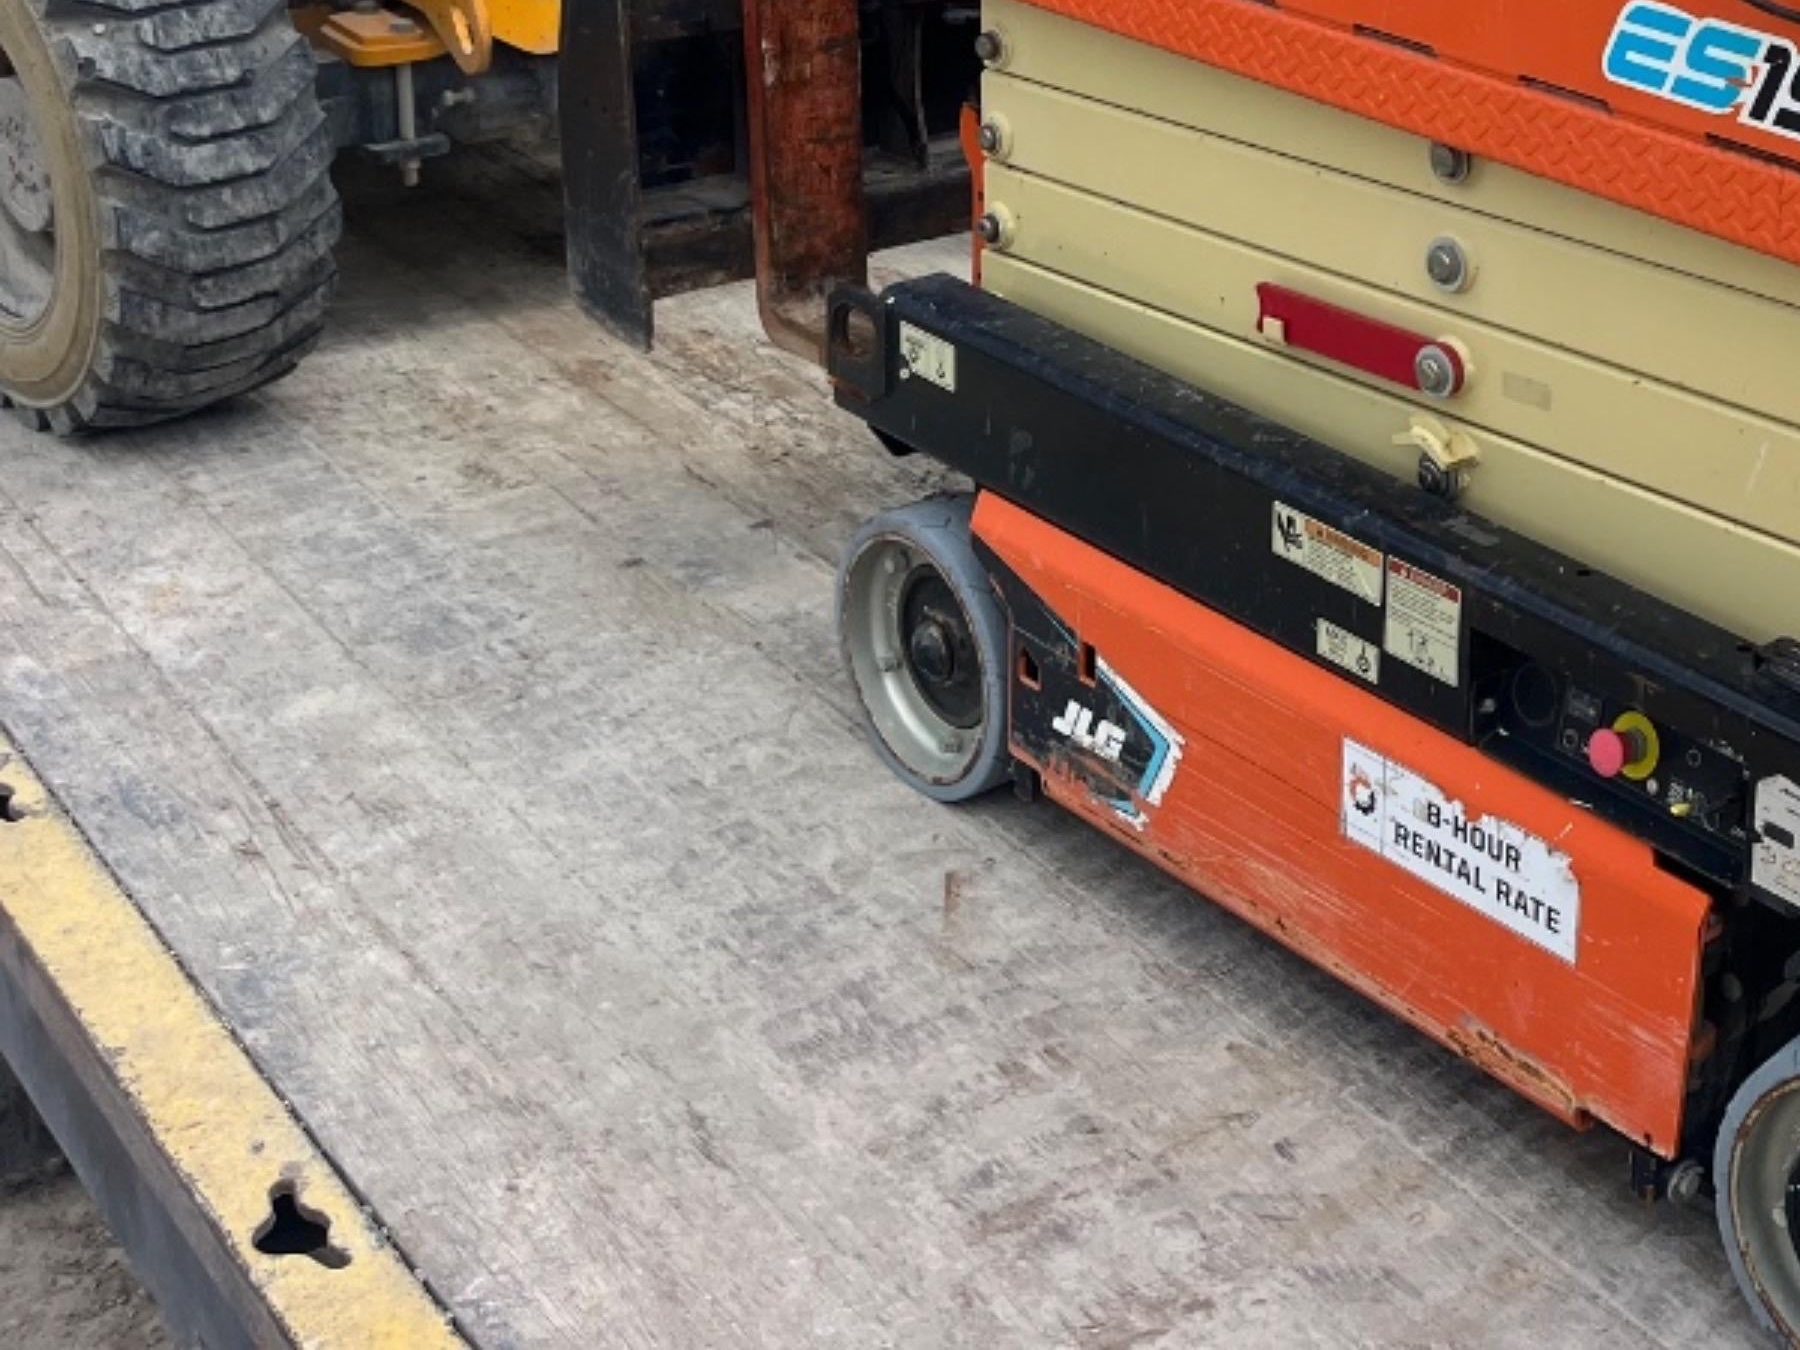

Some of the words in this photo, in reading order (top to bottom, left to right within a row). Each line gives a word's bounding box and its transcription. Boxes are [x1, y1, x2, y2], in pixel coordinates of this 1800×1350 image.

[1052, 698, 1127, 762] JLG
[1393, 821, 1487, 895] RENTAL
[1495, 877, 1561, 935] RATE
